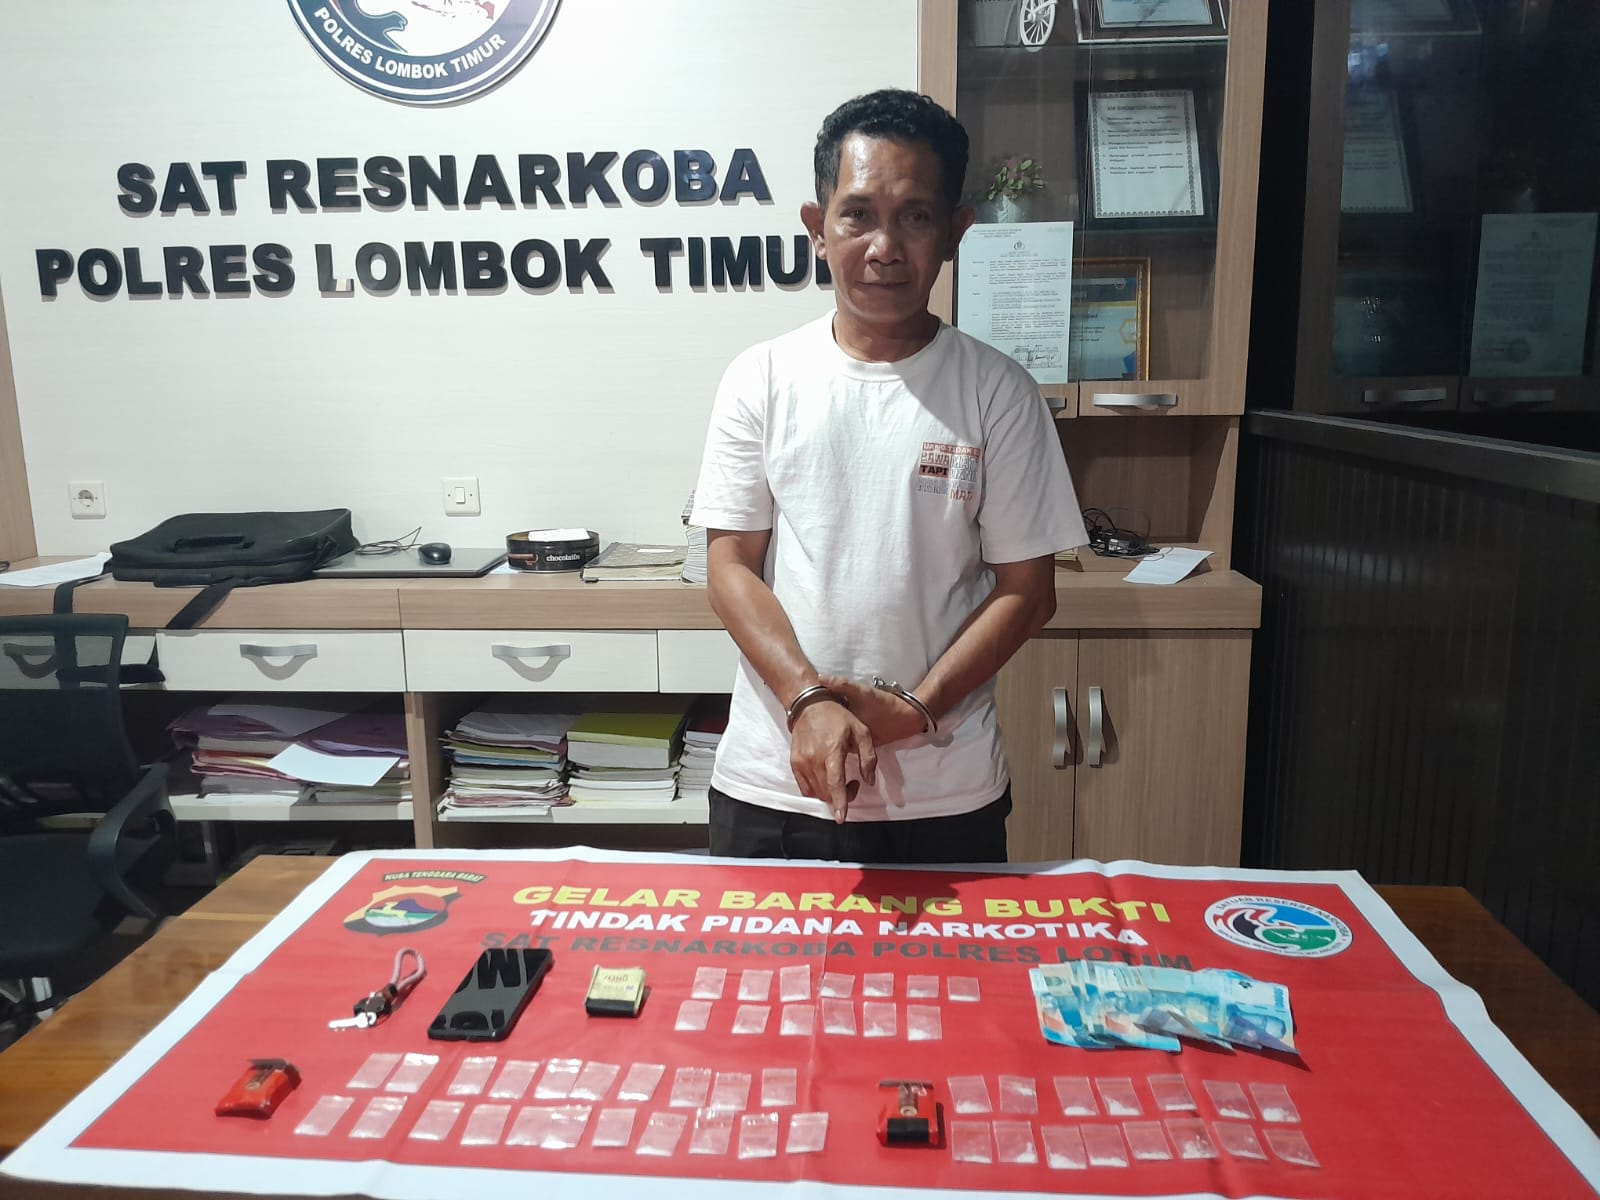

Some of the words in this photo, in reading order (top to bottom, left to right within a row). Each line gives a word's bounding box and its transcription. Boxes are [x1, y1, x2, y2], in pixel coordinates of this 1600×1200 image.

[315, 6, 373, 65] POLRES
[375, 56, 448, 79] LOMBOK
[450, 34, 507, 74] TIMUR
[117, 160, 249, 214] SAT
[266, 149, 776, 212] RESNARKOBA
[36, 242, 296, 298] POLRES
[314, 238, 614, 295] LOMBOK
[920, 465, 949, 475] TAPI
[512, 885, 701, 909] GELAR
[719, 889, 963, 916] BARANG
[983, 897, 1171, 923] BUKTI
[529, 908, 690, 933] TINDAK
[700, 914, 863, 937] PIDANA
[878, 919, 1148, 947] NARKOTIKA
[480, 932, 560, 950] SAT
[570, 934, 857, 958] RESNARKOBA
[872, 941, 1040, 964] POLRES
